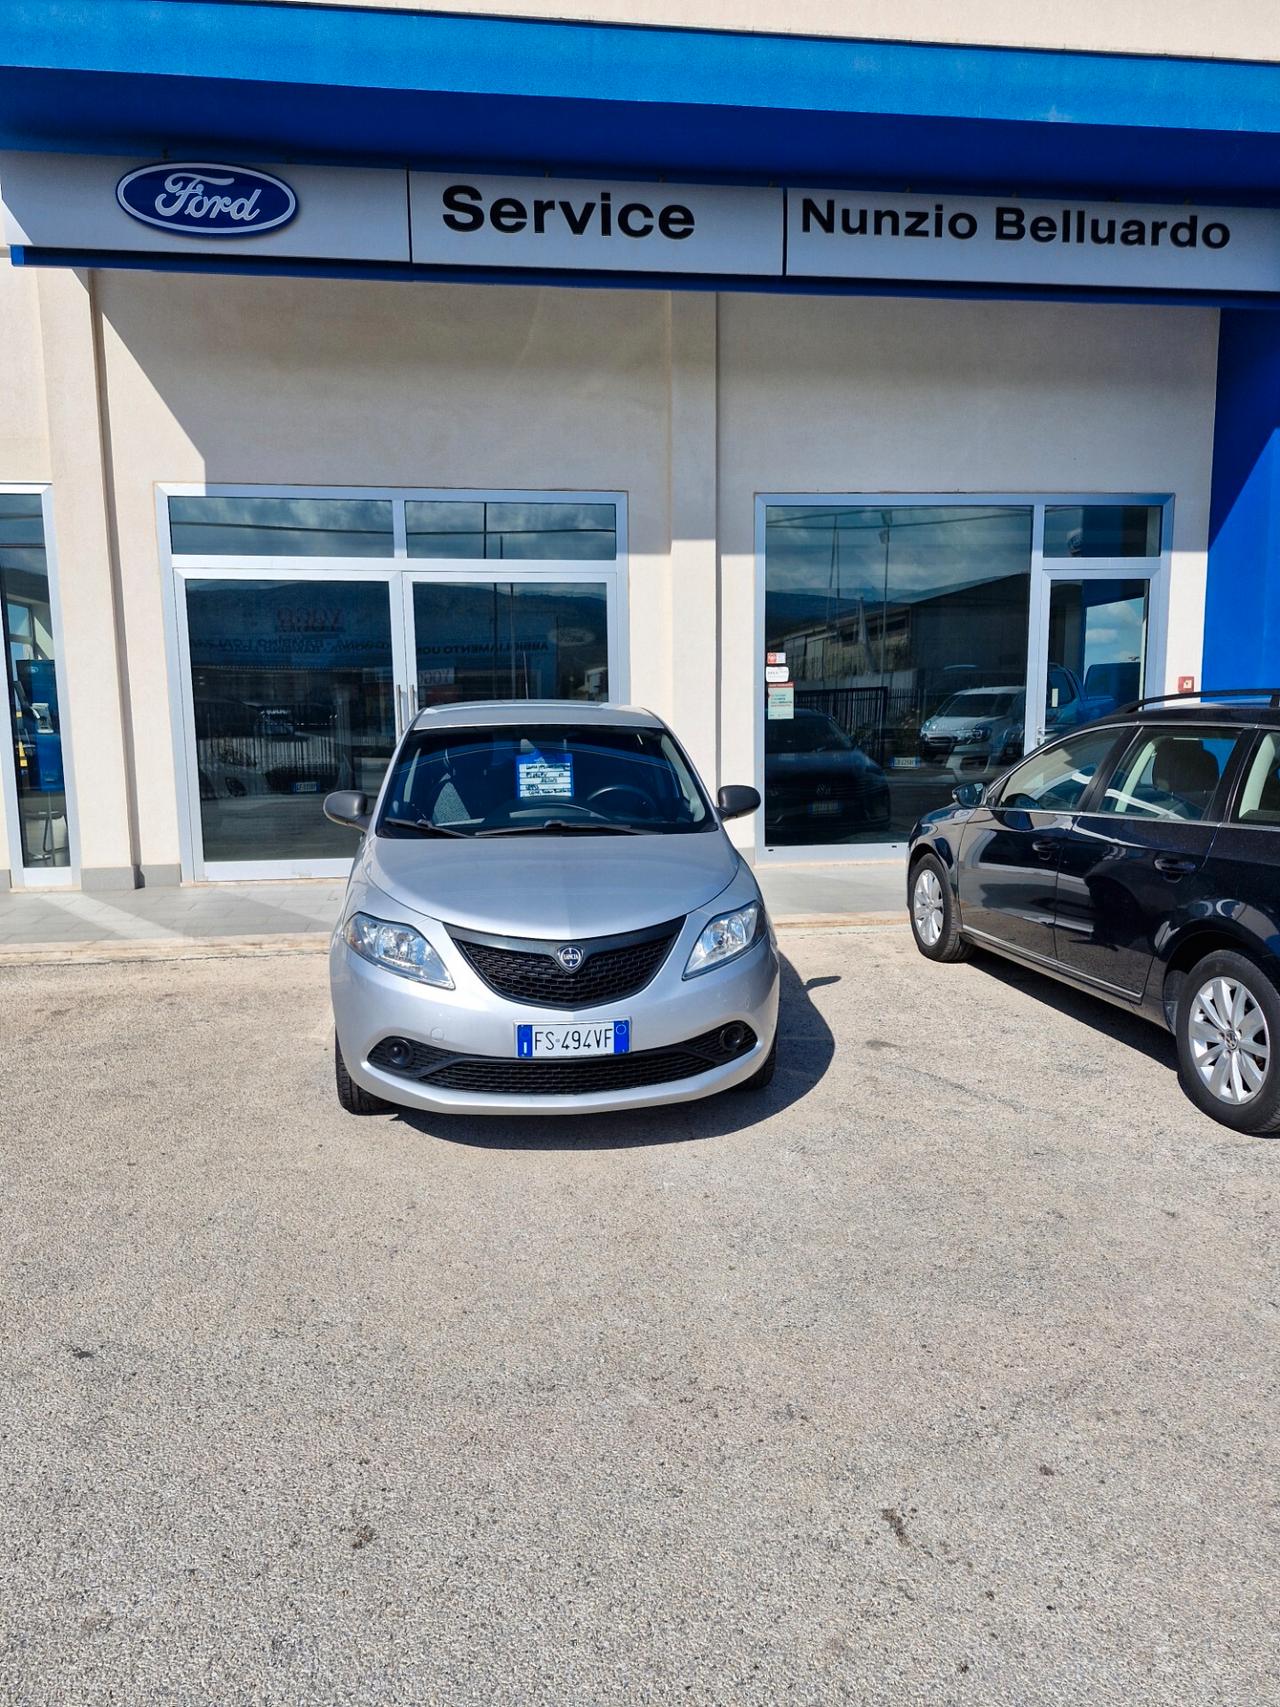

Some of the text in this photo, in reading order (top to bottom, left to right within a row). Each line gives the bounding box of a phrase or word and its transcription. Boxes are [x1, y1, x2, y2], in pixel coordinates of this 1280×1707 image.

[154, 172, 262, 222] Ford
[442, 184, 695, 238] Service
[801, 198, 1231, 250] Nunzio Belluardo
